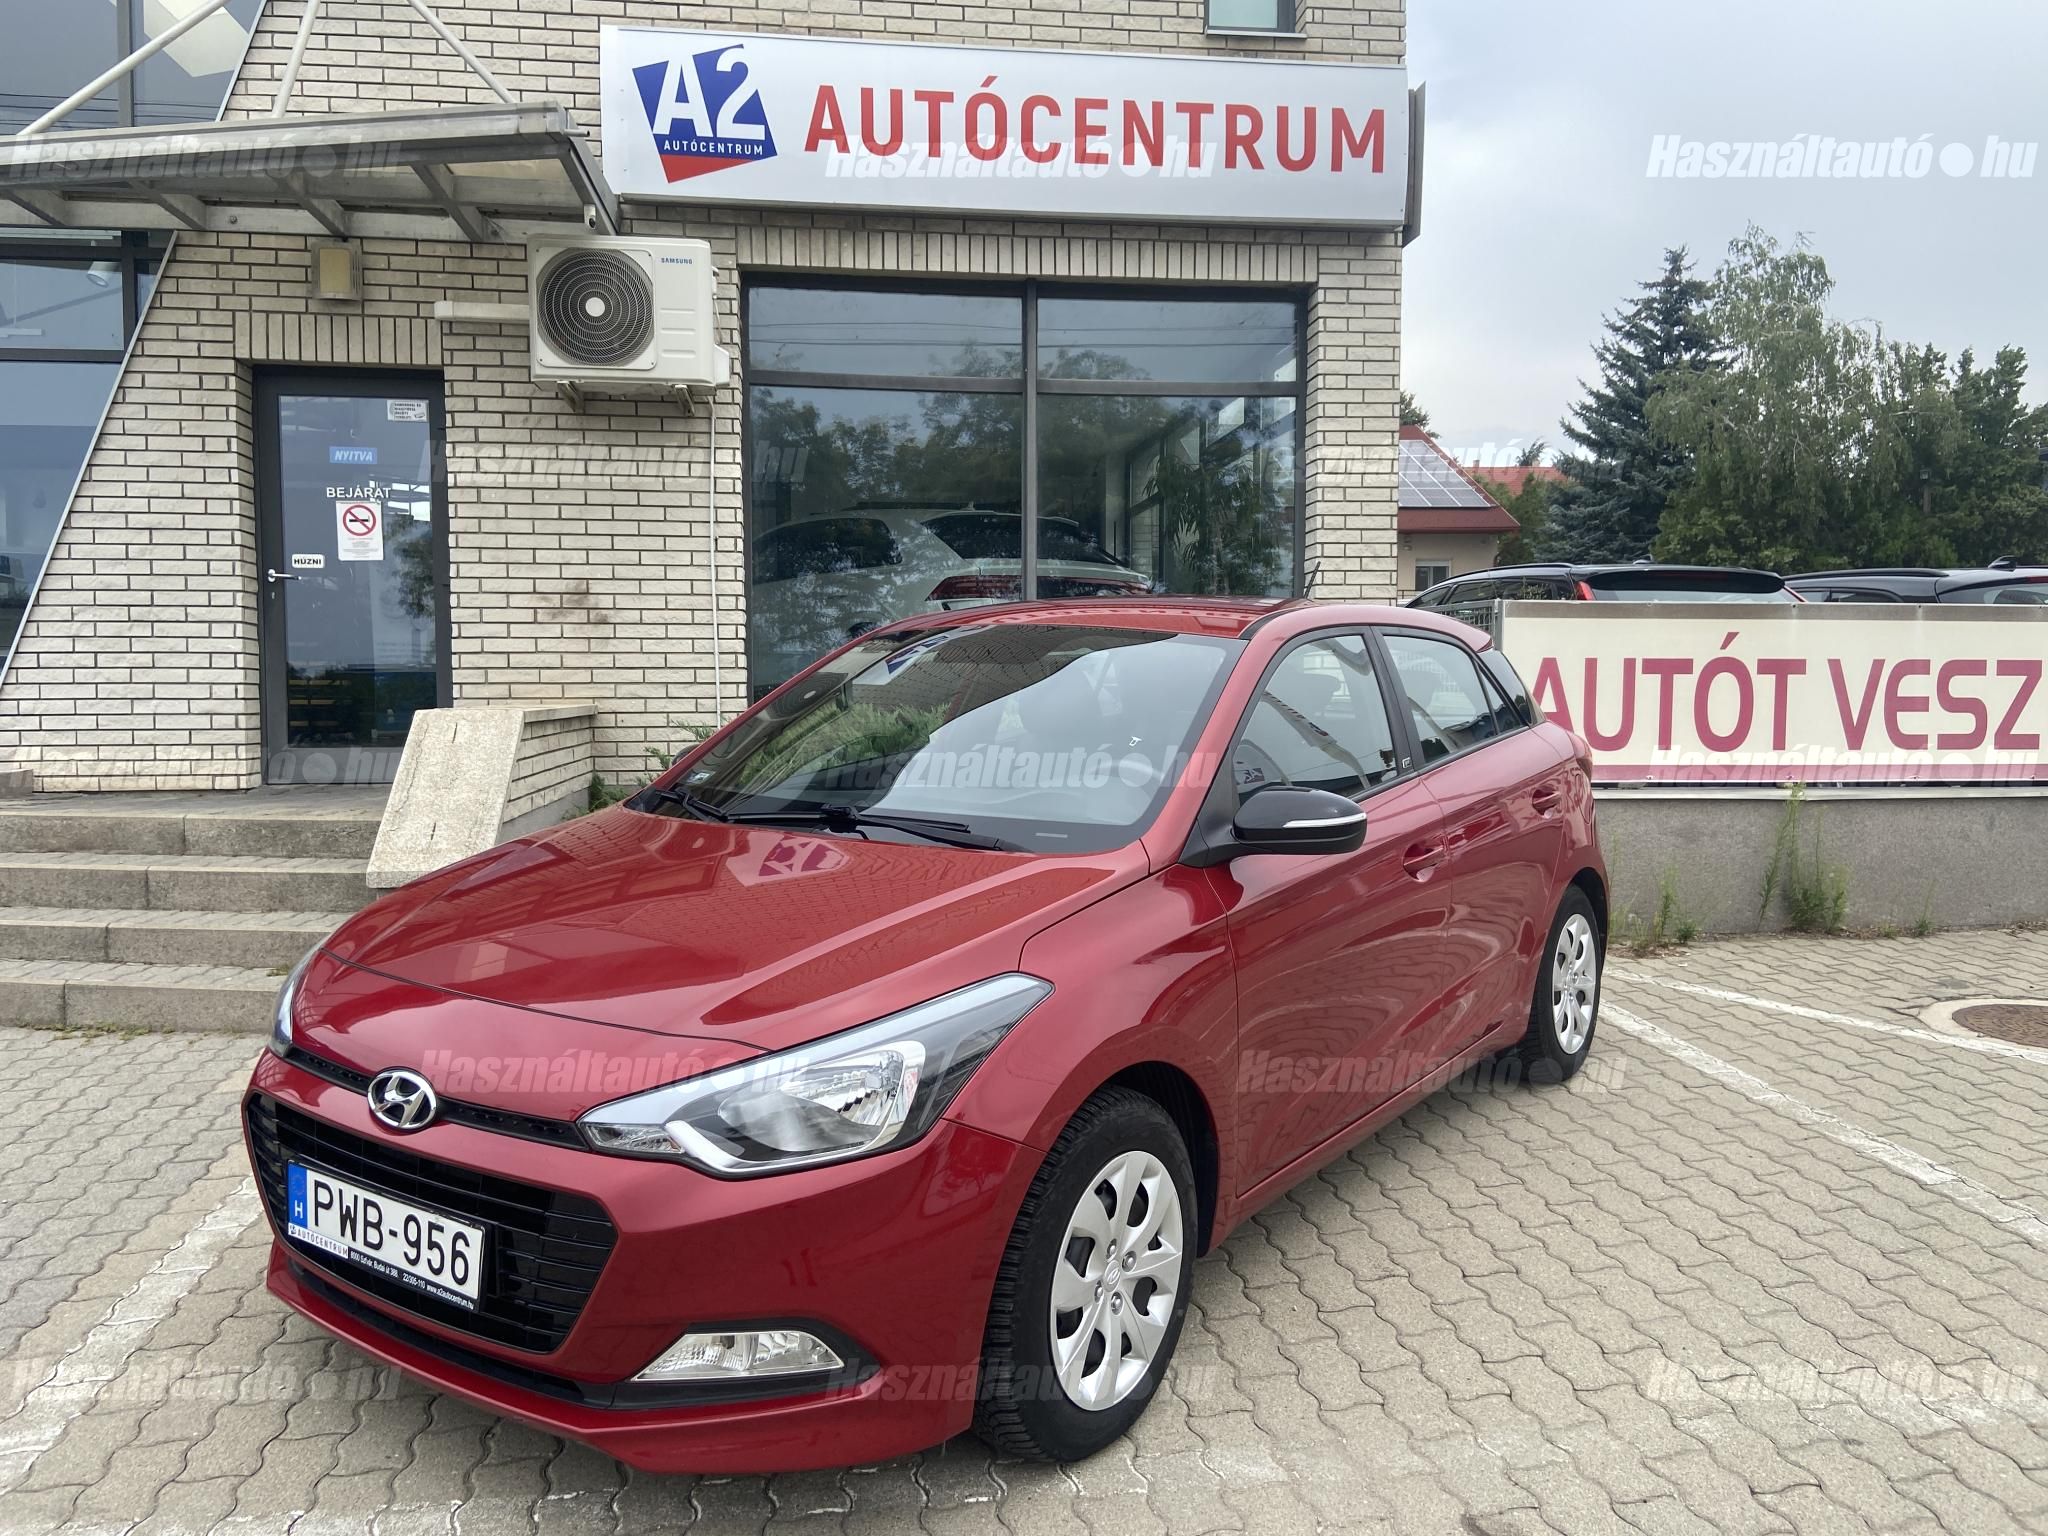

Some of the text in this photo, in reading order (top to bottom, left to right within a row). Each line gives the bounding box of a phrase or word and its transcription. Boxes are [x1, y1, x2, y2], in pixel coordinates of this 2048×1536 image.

[652, 46, 767, 141] A2
[804, 75, 1385, 173] AUTÓCENTRUM
[663, 139, 763, 156] AUTÓCENTRUM
[660, 257, 693, 265] SAMSUNG
[334, 450, 373, 462] NYITVA
[326, 484, 391, 498] BEJÁRAT
[293, 556, 322, 565] HÚZNI
[1531, 631, 2043, 752] AUTÓT VESZ
[294, 1199, 304, 1219] H
[314, 1178, 471, 1287] PWB-956
